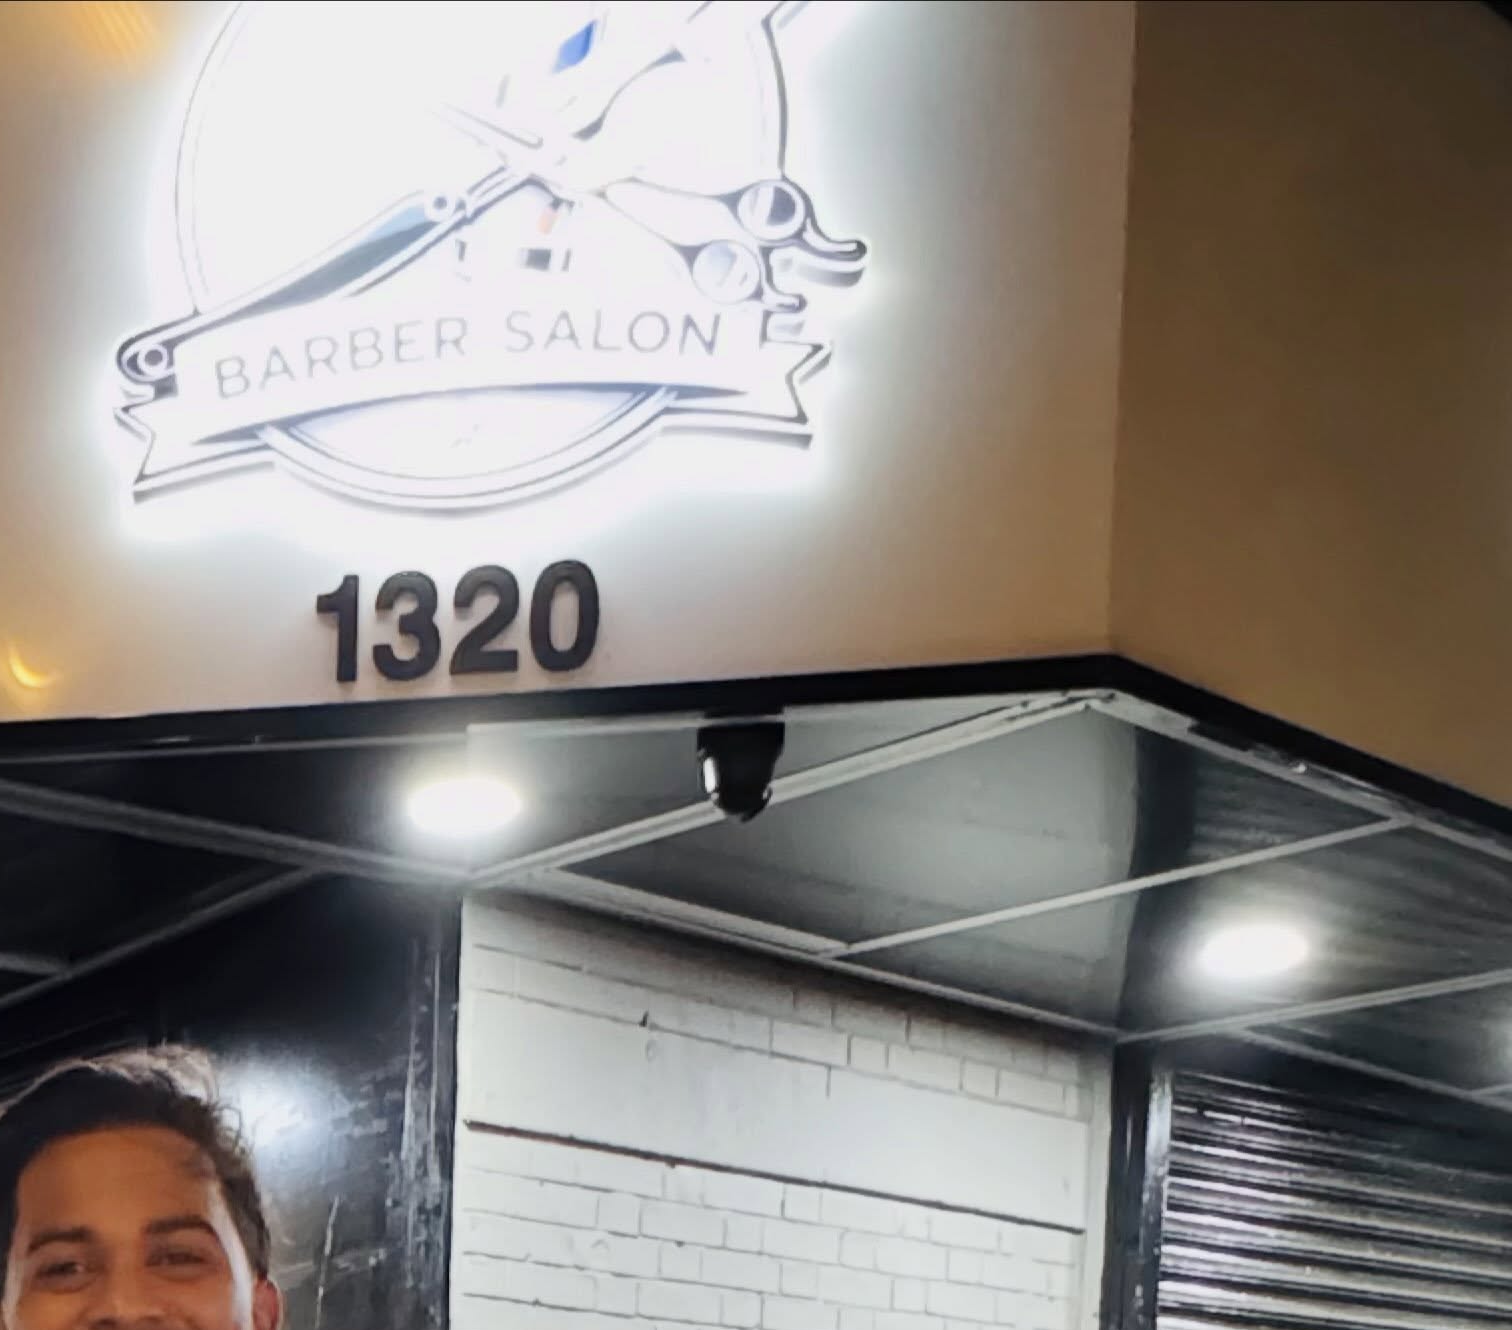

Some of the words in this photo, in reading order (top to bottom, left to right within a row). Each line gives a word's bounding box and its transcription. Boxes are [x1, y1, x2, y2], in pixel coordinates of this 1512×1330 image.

[215, 316, 469, 399] BARBER
[504, 308, 722, 356] SALON
[316, 561, 600, 683] 1320
